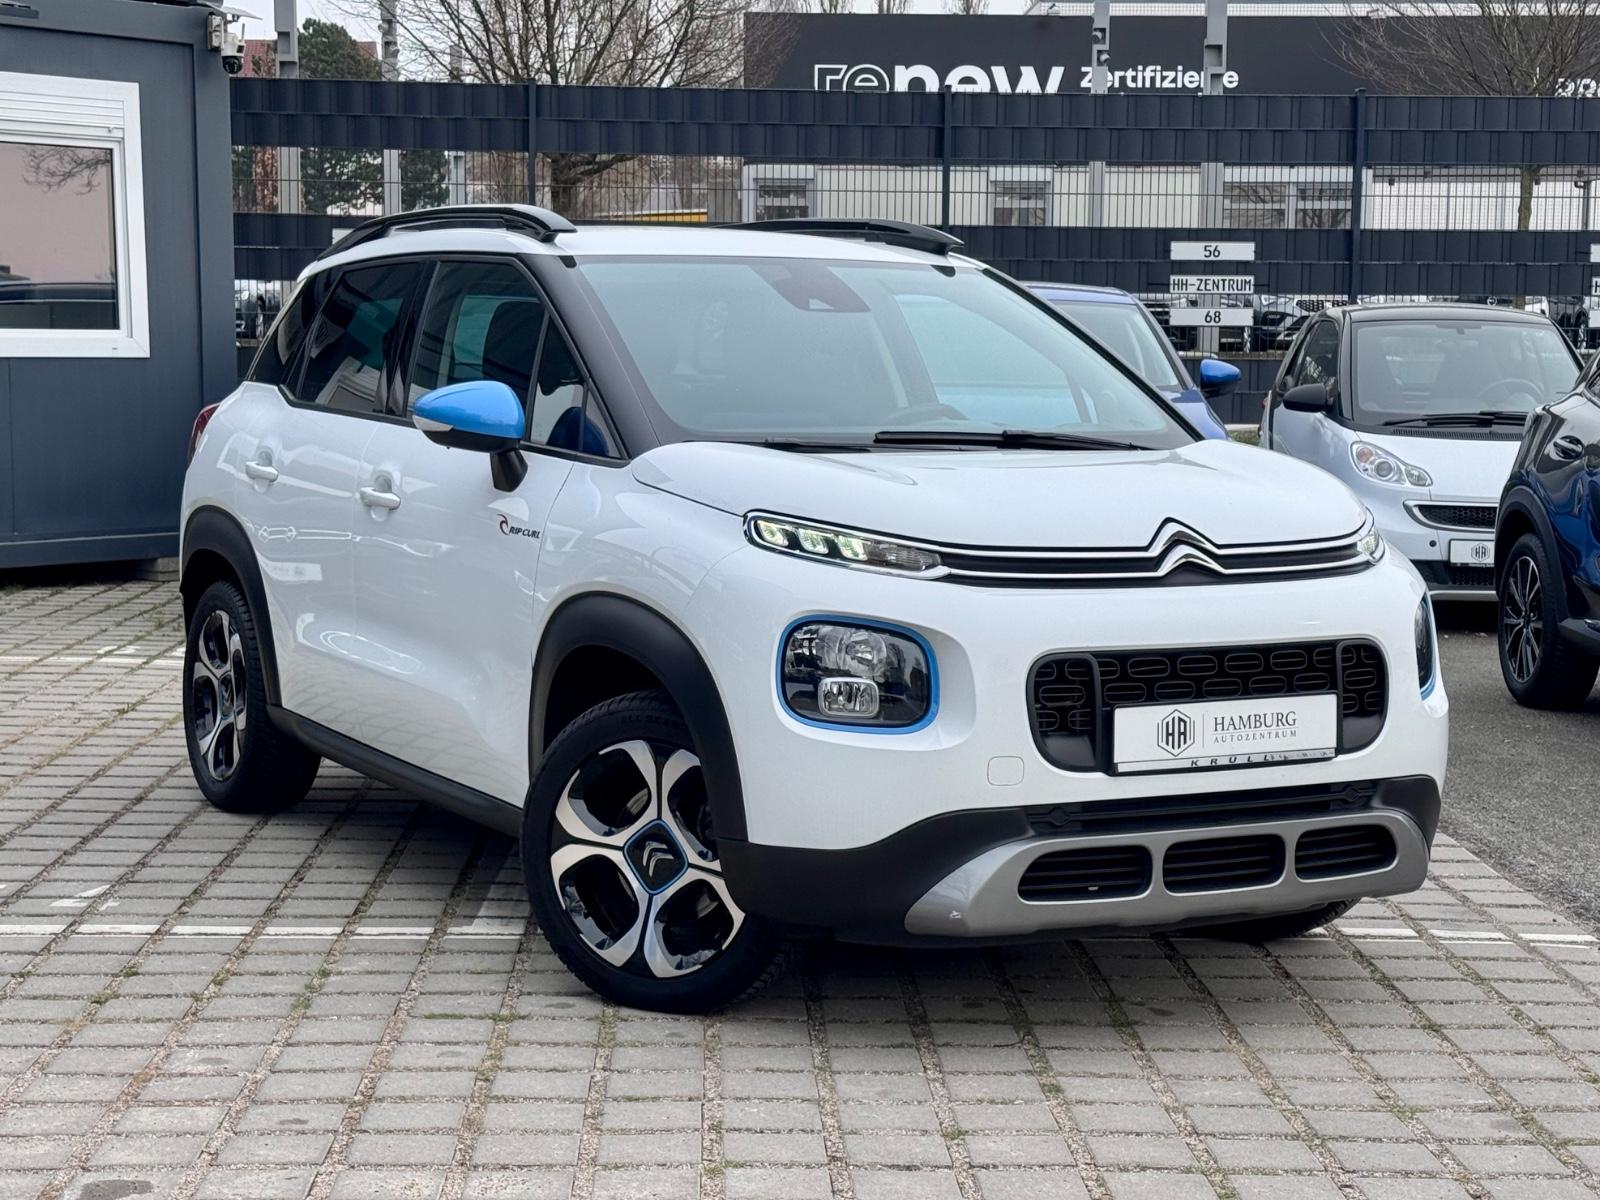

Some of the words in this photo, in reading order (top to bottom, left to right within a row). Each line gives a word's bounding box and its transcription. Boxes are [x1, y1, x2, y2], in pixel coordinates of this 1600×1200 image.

[813, 64, 1065, 94] renew
[1203, 244, 1221, 258] 56
[1172, 278, 1252, 292] HH-ZENTRUM
[1204, 310, 1222, 323] 68
[509, 526, 523, 535] RIP
[522, 528, 541, 539] CURL
[1213, 711, 1297, 732] HAMBURG
[1213, 729, 1298, 744] AUTOZENTRUM
